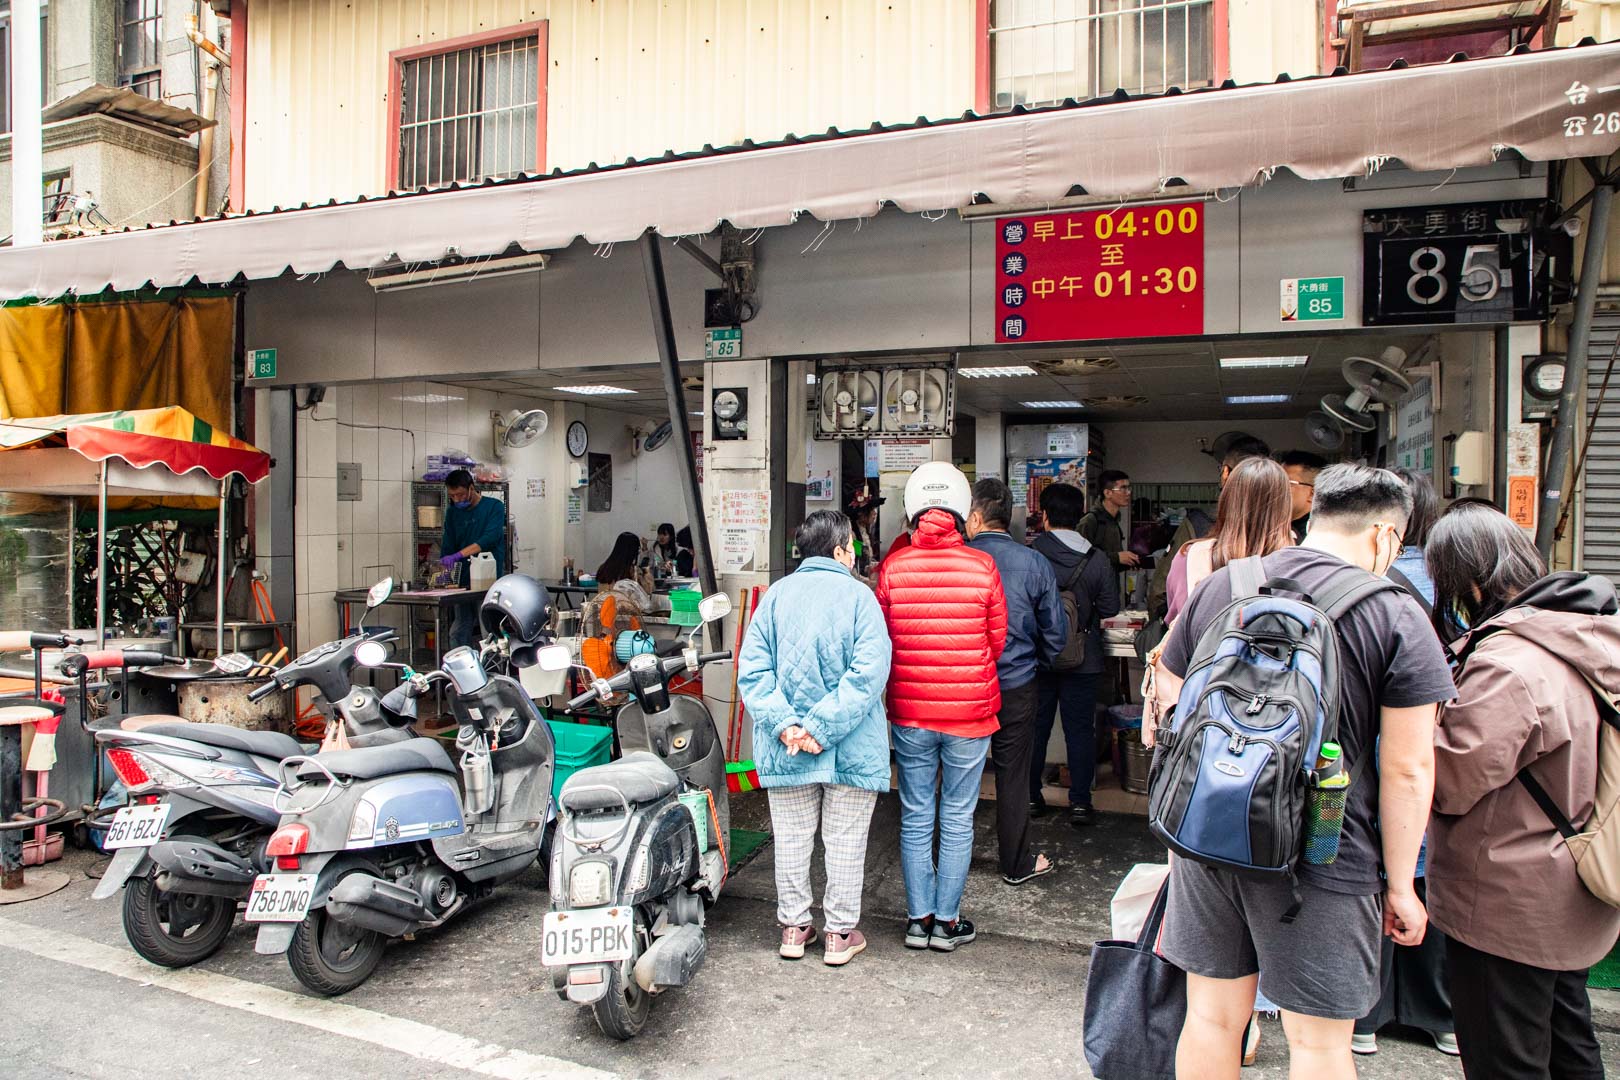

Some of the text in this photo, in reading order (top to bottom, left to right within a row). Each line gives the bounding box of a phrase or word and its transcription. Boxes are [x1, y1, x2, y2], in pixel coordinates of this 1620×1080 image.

[1592, 111, 1620, 135] 26
[1032, 207, 1198, 242] 早上 04:00
[1385, 207, 1489, 236] 大勇街
[1099, 243, 1125, 266] 至
[1005, 224, 1024, 338] 營業時間
[1031, 266, 1198, 299] 中午 01:30
[1406, 244, 1500, 305] 85
[1299, 282, 1329, 294] 大勇街
[1308, 298, 1333, 313] 85
[718, 341, 734, 355] 85
[260, 363, 271, 373] 83
